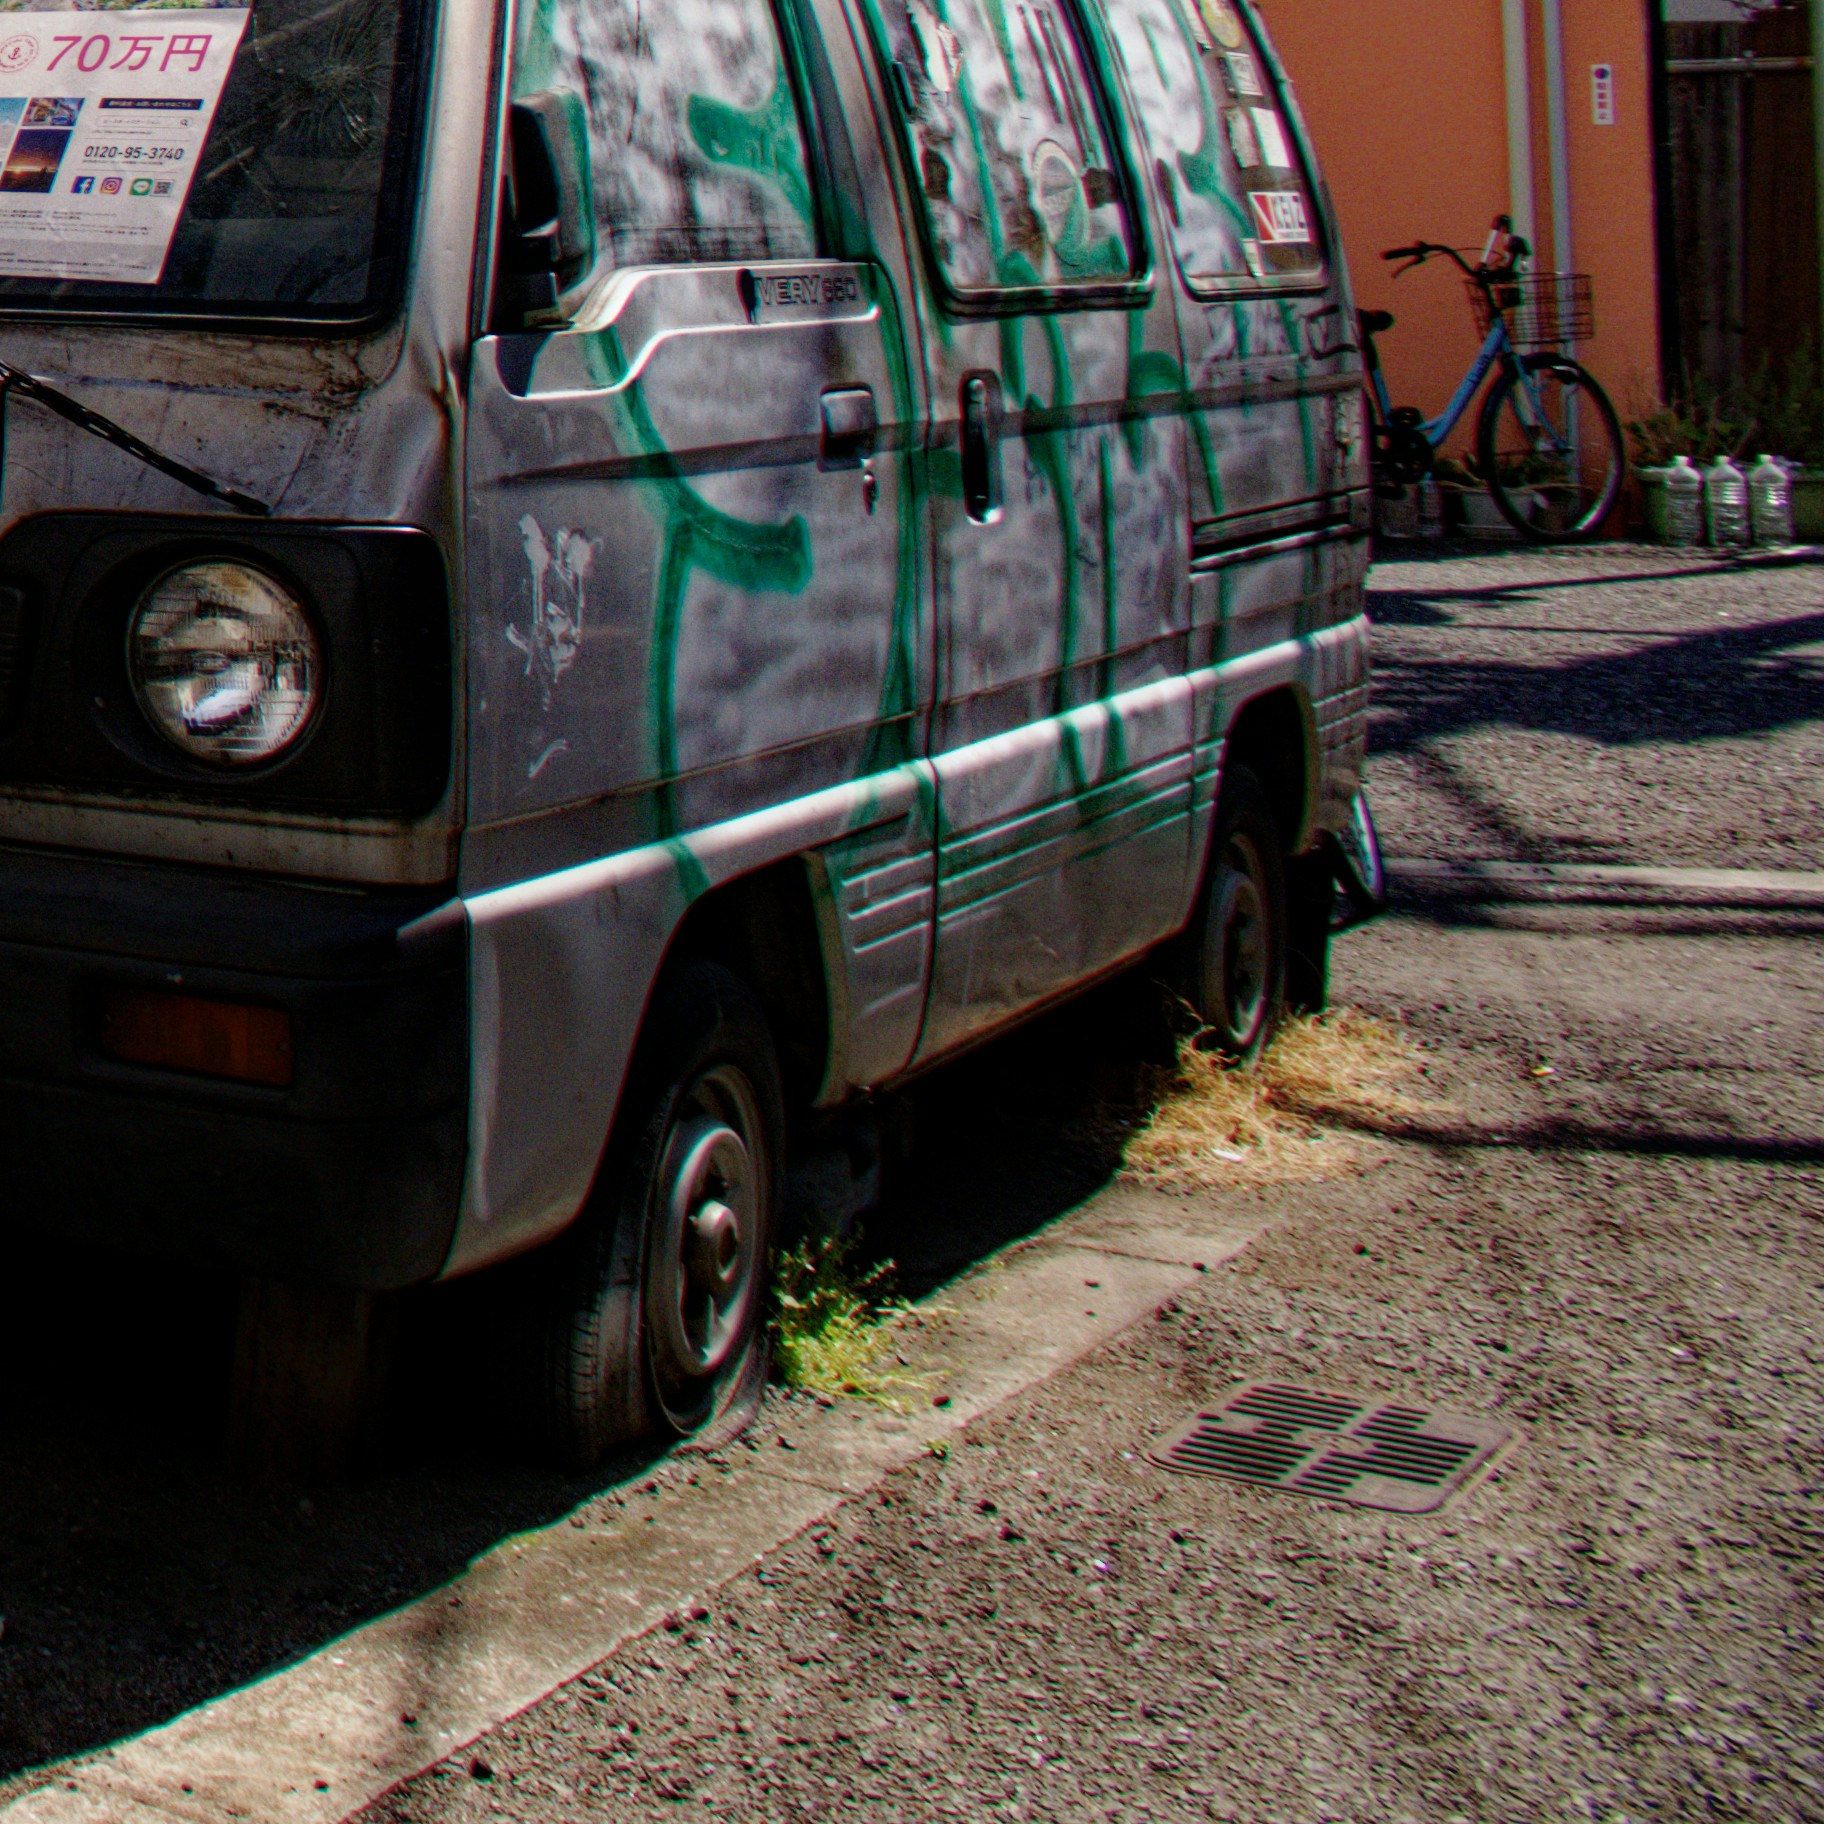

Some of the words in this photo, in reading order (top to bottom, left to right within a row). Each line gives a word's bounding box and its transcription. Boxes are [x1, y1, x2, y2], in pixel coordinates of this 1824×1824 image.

[46, 33, 213, 73] 70万円
[84, 145, 185, 160] 0120-95-3740
[749, 274, 821, 305] VERY
